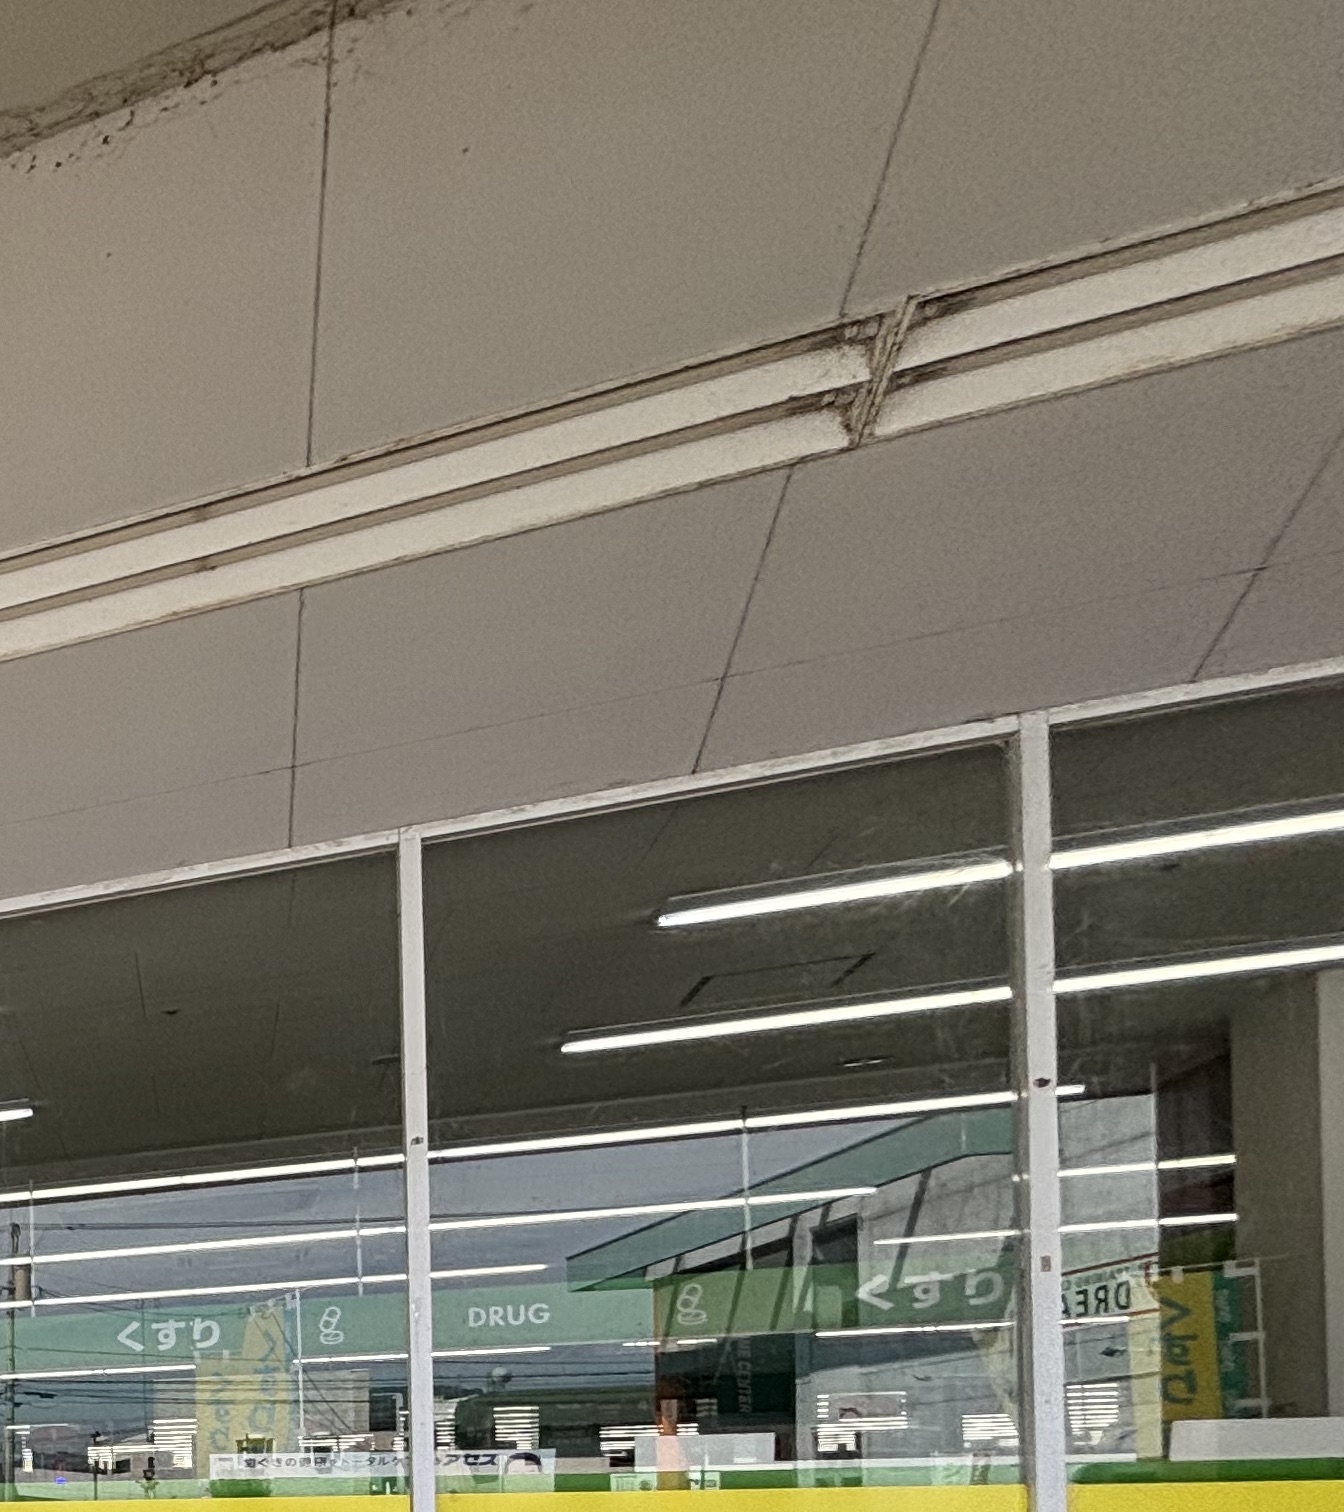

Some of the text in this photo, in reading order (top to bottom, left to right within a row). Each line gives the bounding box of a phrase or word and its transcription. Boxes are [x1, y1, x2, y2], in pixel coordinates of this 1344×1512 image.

[855, 1271, 1005, 1311] くすり
[468, 1303, 551, 1327] DRUG
[117, 1318, 221, 1352] くすり
